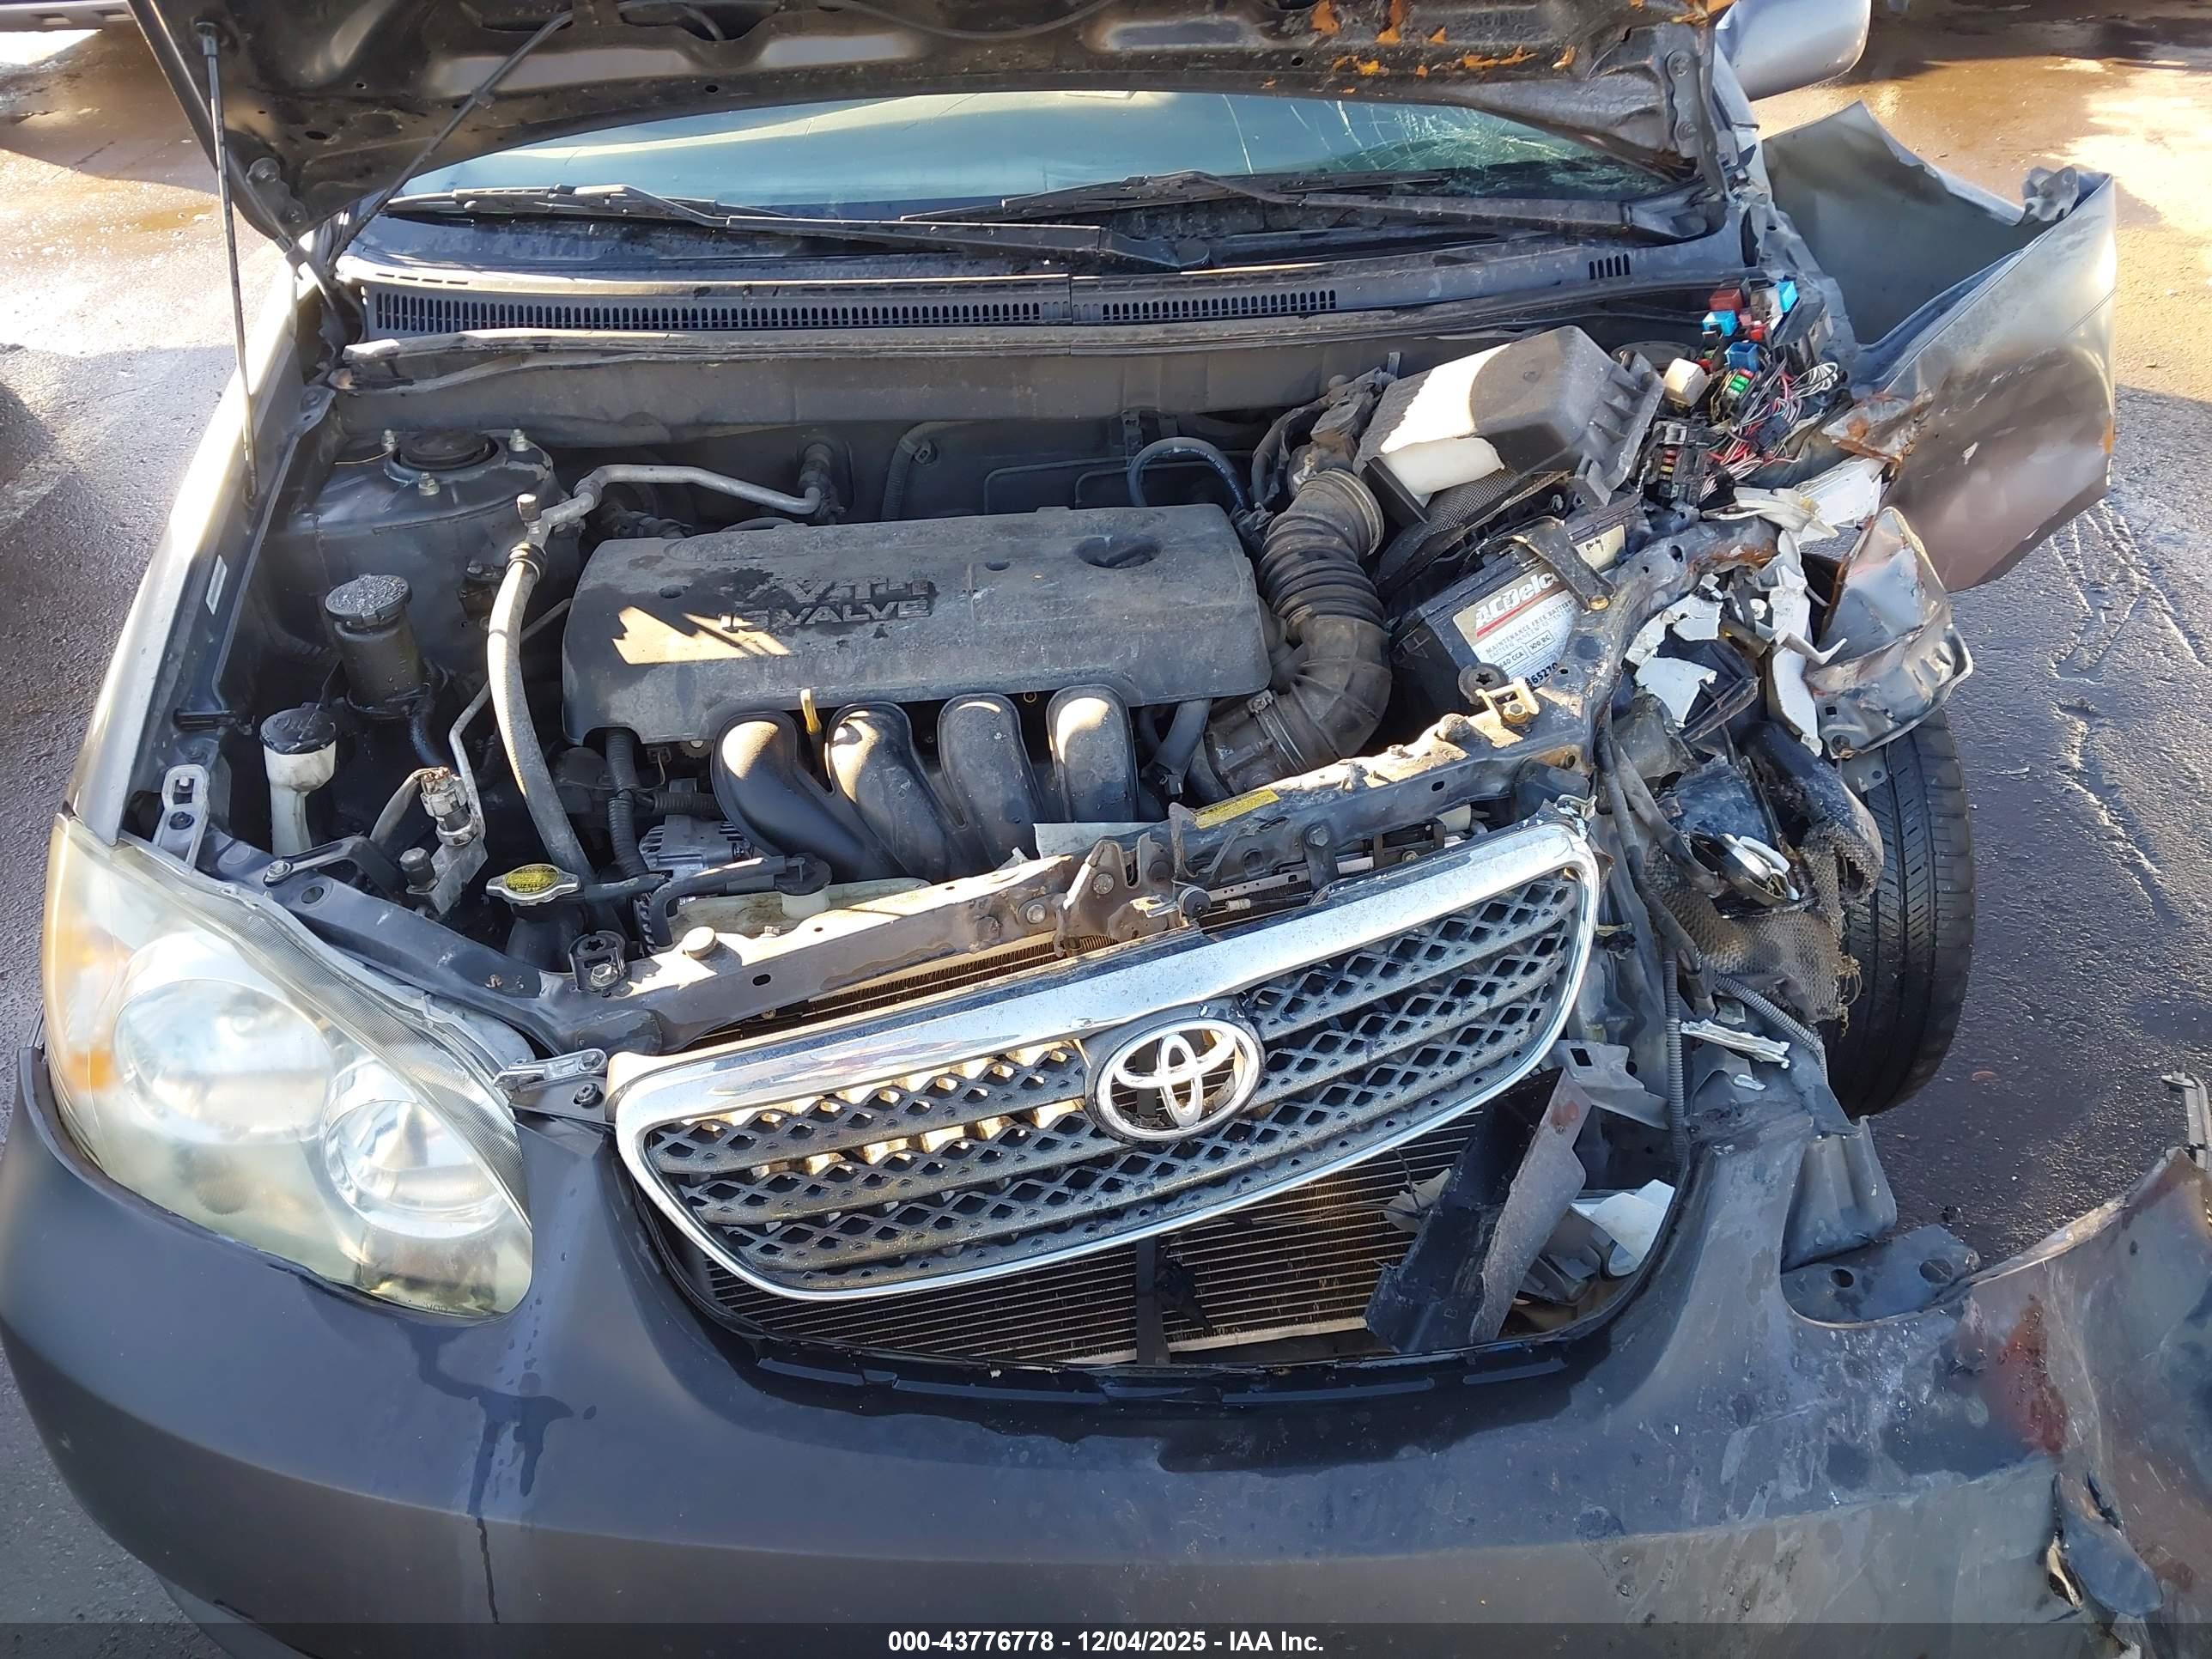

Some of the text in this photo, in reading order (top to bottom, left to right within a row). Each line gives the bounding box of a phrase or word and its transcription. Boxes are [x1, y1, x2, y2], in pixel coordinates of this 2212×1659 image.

[777, 599, 933, 627] VALVE
[1486, 623, 1530, 653] MAINTENANCE
[1531, 614, 1547, 626] FREE
[1511, 651, 1524, 661] CCA
